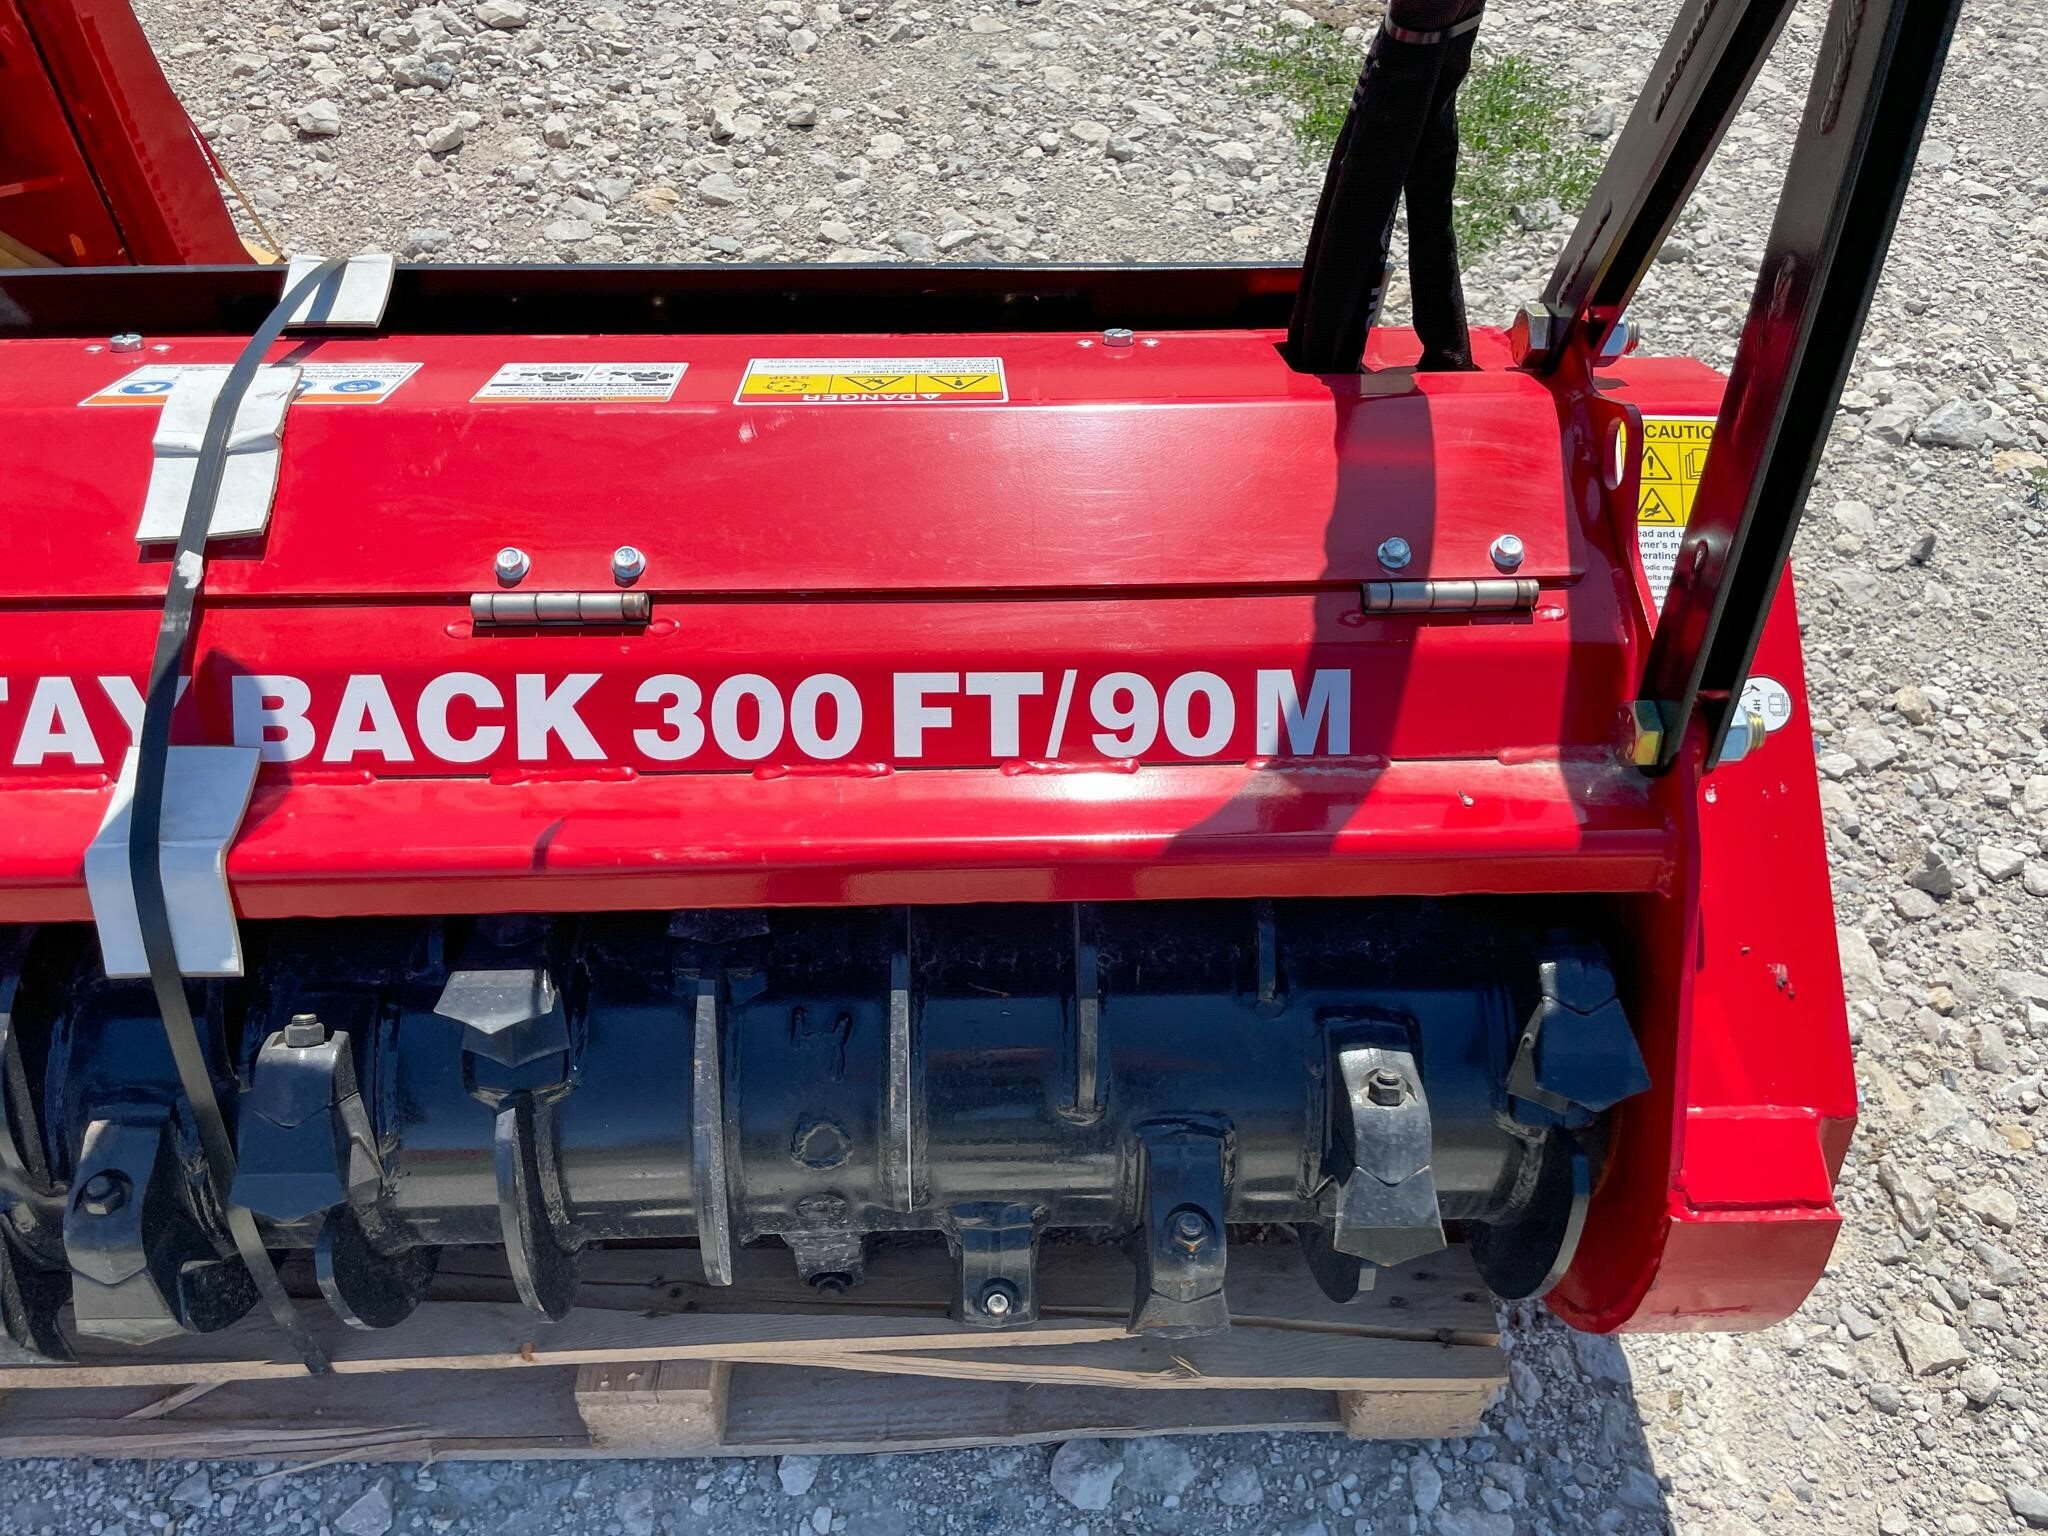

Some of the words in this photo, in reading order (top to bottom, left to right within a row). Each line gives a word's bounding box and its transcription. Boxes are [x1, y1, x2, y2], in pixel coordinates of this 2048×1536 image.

[802, 393, 917, 401] DANGER
[1644, 424, 1714, 440] CAUTIO
[1638, 530, 1654, 538] ead
[1656, 530, 1676, 538] and
[1643, 551, 1677, 561] erating
[0, 675, 190, 765] AY
[232, 671, 607, 762] BACK
[632, 673, 863, 761] 300
[893, 669, 1236, 760] FT/90
[1257, 668, 1352, 756] M
